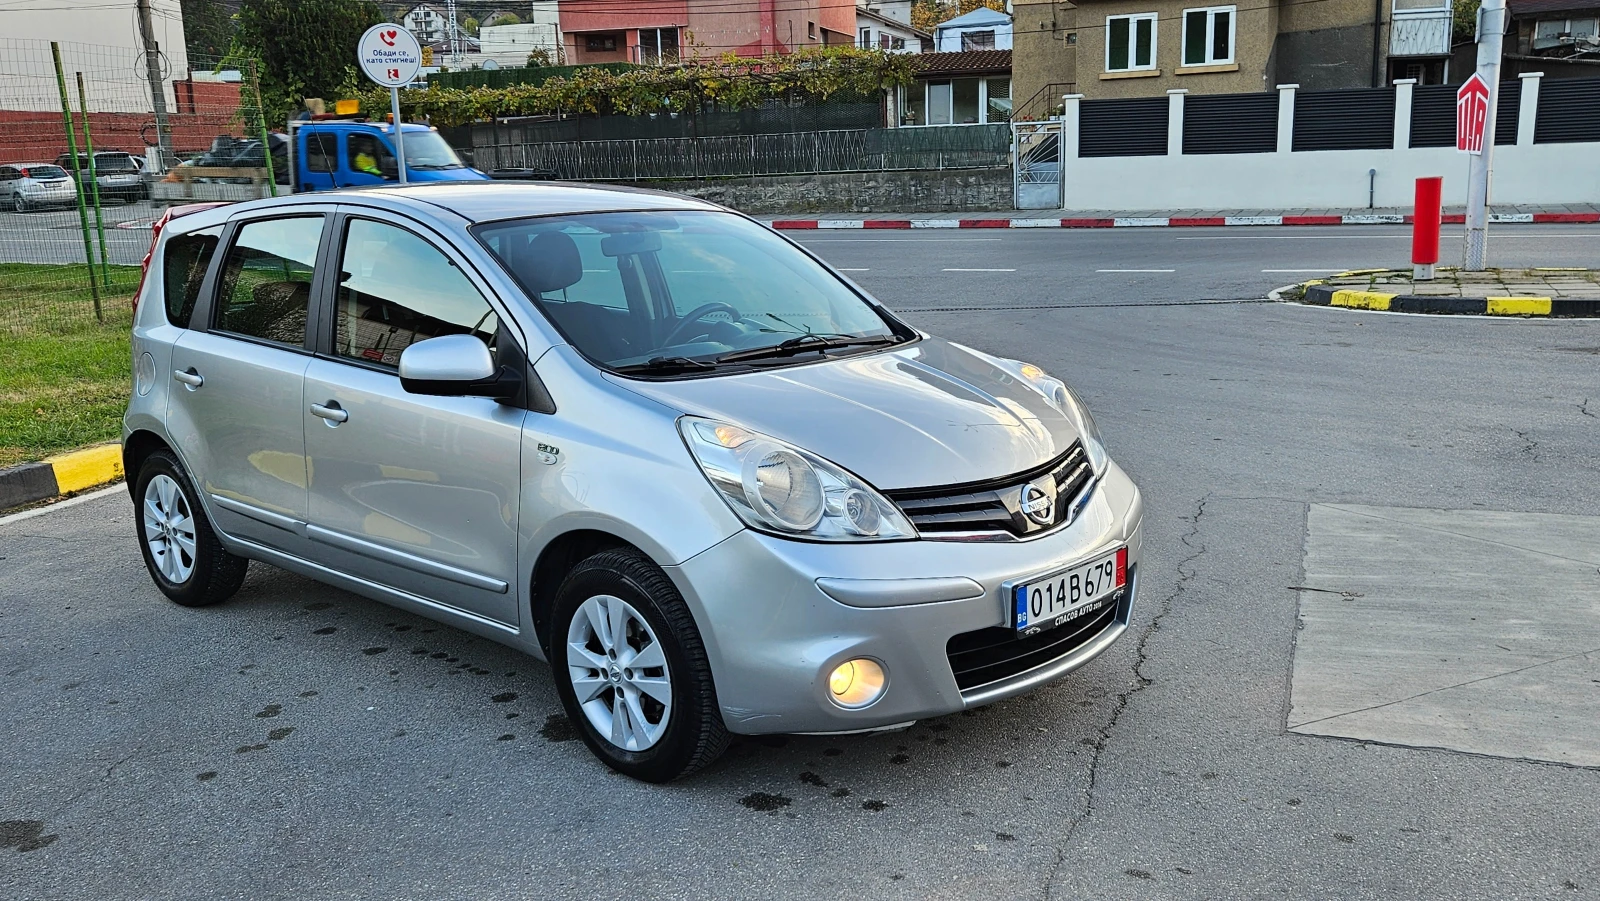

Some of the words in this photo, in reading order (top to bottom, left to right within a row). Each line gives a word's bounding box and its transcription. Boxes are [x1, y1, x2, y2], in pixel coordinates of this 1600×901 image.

[373, 49, 397, 57] Обади
[1017, 612, 1027, 623] BG
[1055, 610, 1078, 626] СПАСОВ
[1079, 604, 1093, 617] АУТО
